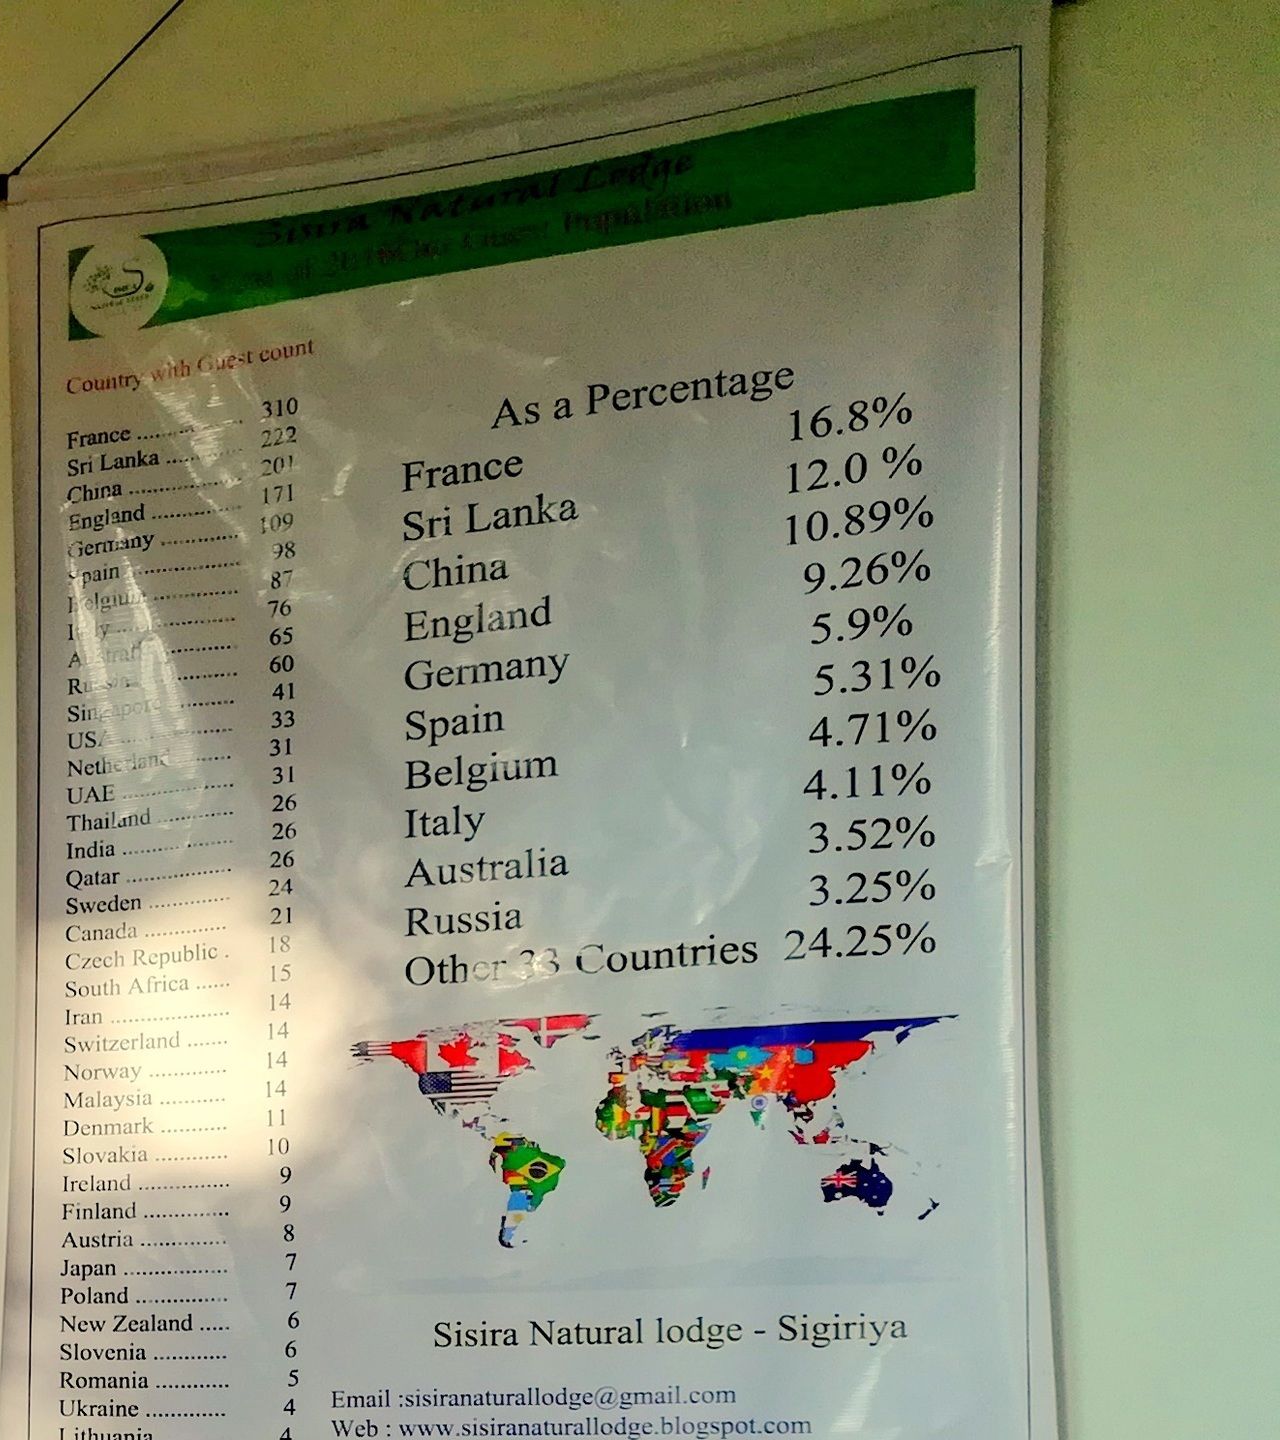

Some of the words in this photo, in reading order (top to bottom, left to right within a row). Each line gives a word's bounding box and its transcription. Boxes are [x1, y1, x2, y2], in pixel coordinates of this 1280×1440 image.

[66, 373, 141, 395] Country
[150, 360, 191, 382] with
[197, 350, 253, 373] Guest
[259, 339, 314, 363] count
[491, 397, 540, 429] As
[553, 400, 574, 420] a
[586, 367, 795, 416] Percentage
[67, 428, 131, 449] France
[261, 397, 298, 419] 310
[402, 454, 524, 493] France
[789, 392, 913, 442] 16.8%
[68, 459, 93, 477] Sri
[100, 450, 160, 471] Lanka
[261, 426, 297, 448] 222
[403, 506, 453, 541] Sri
[465, 494, 580, 534] Lanka
[787, 451, 868, 494] 12.0
[403, 554, 508, 592] China
[785, 495, 934, 546] 10.89%
[403, 597, 553, 645] England
[803, 549, 931, 595] 9.26%
[403, 650, 570, 691] Germany
[810, 603, 913, 645] 5.9%
[813, 655, 941, 697] 5.31%
[404, 703, 505, 747] Spain
[808, 708, 938, 748] 4.71%
[404, 752, 559, 792] Belgium
[803, 761, 931, 801] 4.11%
[404, 806, 486, 842] Italy
[808, 815, 936, 854] 3.52%
[65, 870, 120, 890] Qatar
[269, 850, 295, 868] 26
[403, 848, 569, 889] Australia
[808, 868, 936, 907] 3.25%
[65, 895, 141, 915] Sweden
[268, 879, 293, 896] 24
[404, 901, 523, 938] Russia
[404, 955, 507, 987] Other
[575, 934, 759, 976] Countries
[783, 921, 937, 962] 24.25%
[62, 1202, 137, 1220] Finland
[62, 1230, 133, 1248] Austria
[60, 1259, 116, 1280] Japan
[61, 1287, 129, 1304] Poland
[60, 1316, 105, 1332] New
[113, 1313, 193, 1332] Zealand
[434, 1321, 518, 1348] Sisira
[529, 1318, 643, 1346] Natural
[656, 1317, 743, 1349] lodge
[778, 1313, 908, 1348] Sigiriya
[60, 1343, 146, 1361] Slovenia
[59, 1371, 148, 1389] Romania
[331, 1390, 391, 1408] Email
[59, 1399, 139, 1417] Ukraine
[331, 1419, 378, 1438] Web
[399, 1416, 812, 1440] www.sisiranaturallodge.blogspot.com
